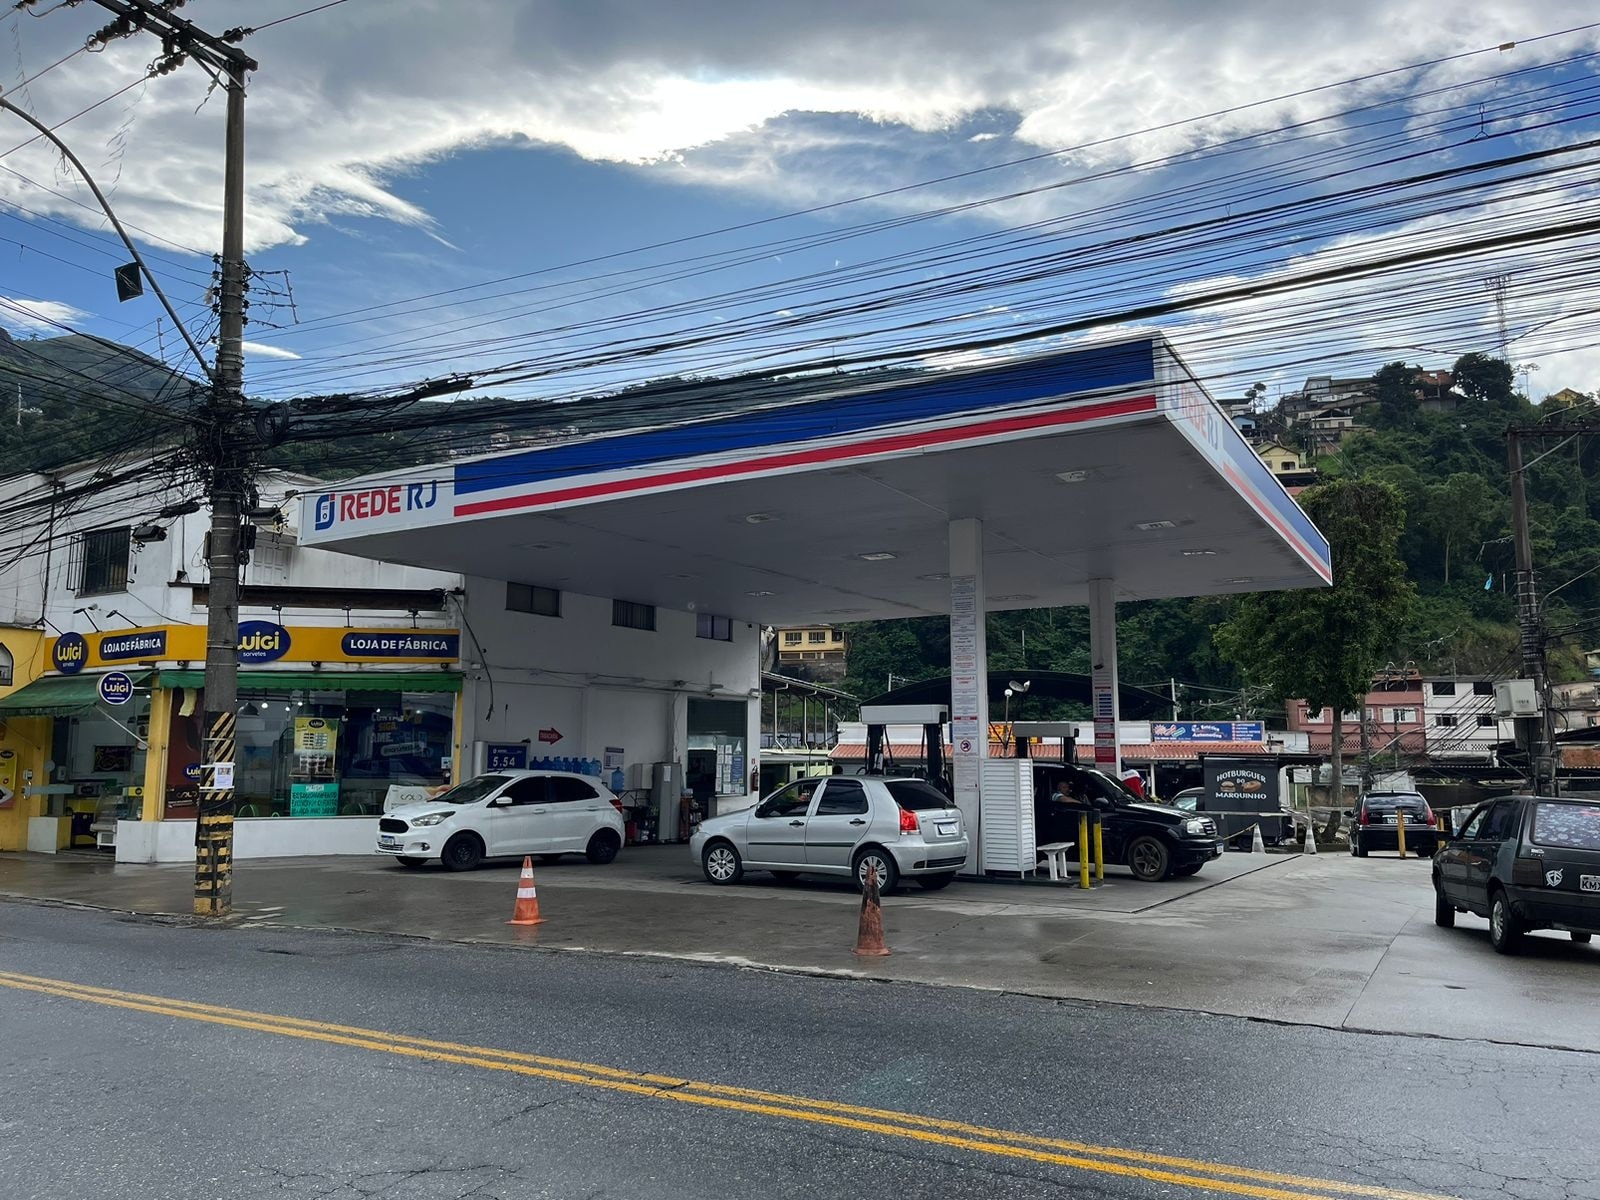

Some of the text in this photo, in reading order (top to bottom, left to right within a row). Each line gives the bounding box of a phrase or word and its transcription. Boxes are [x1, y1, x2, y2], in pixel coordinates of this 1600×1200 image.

[340, 479, 437, 521] REDE RJ
[103, 638, 161, 653] LOJA DE FÁBRICA
[350, 638, 448, 650] LOJA DE FÁBRICA
[492, 756, 515, 767] 5.54
[1216, 770, 1266, 783] HOTBURGUER
[1215, 792, 1267, 800] MARQUINHO
